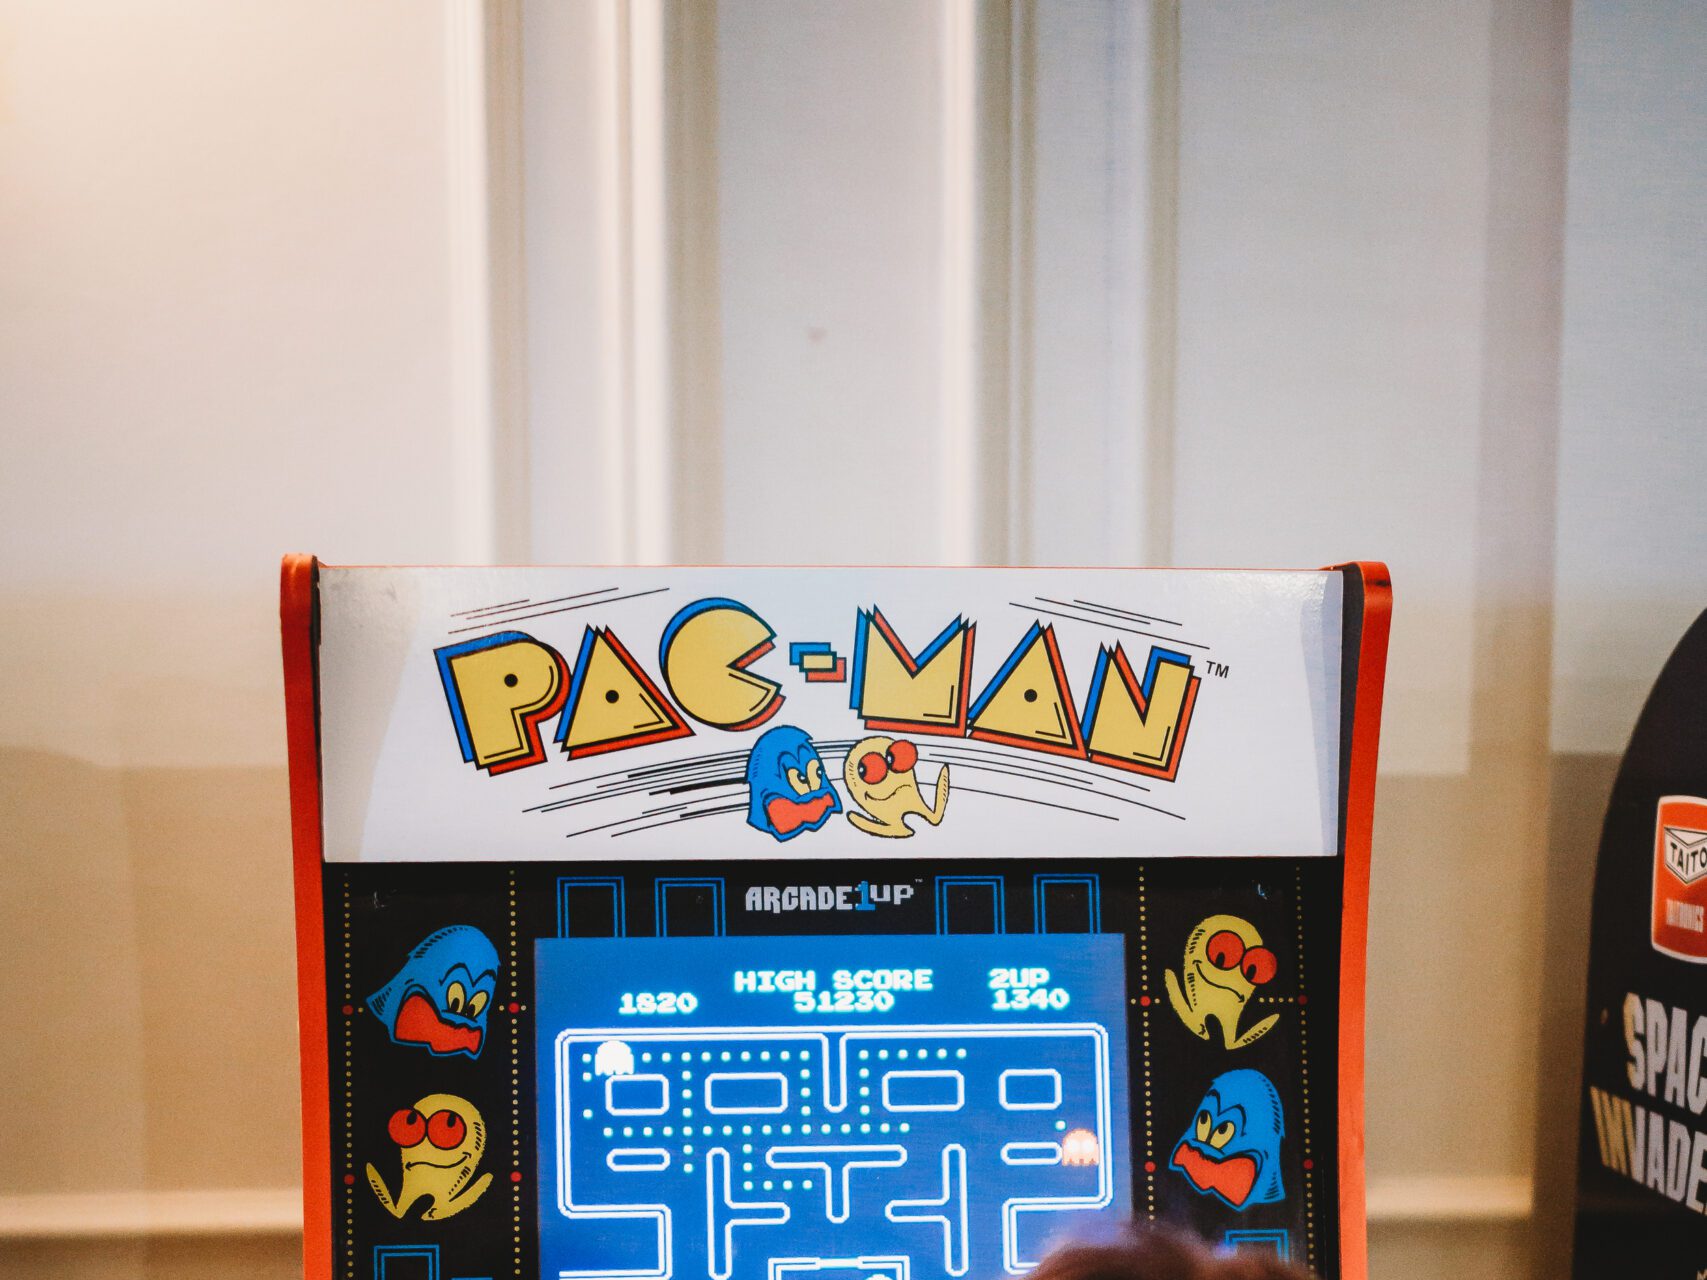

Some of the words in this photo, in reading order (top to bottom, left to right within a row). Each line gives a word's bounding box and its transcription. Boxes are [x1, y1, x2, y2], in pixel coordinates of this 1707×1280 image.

[433, 597, 1201, 782] PAC-MAN
[1670, 841, 1707, 876] TAITO
[734, 970, 816, 993] HIGH
[832, 968, 934, 991] SCORE
[988, 967, 1050, 989] 2UP
[619, 992, 699, 1014] 1820
[793, 990, 895, 1013] 51230
[991, 988, 1070, 1010] 1340
